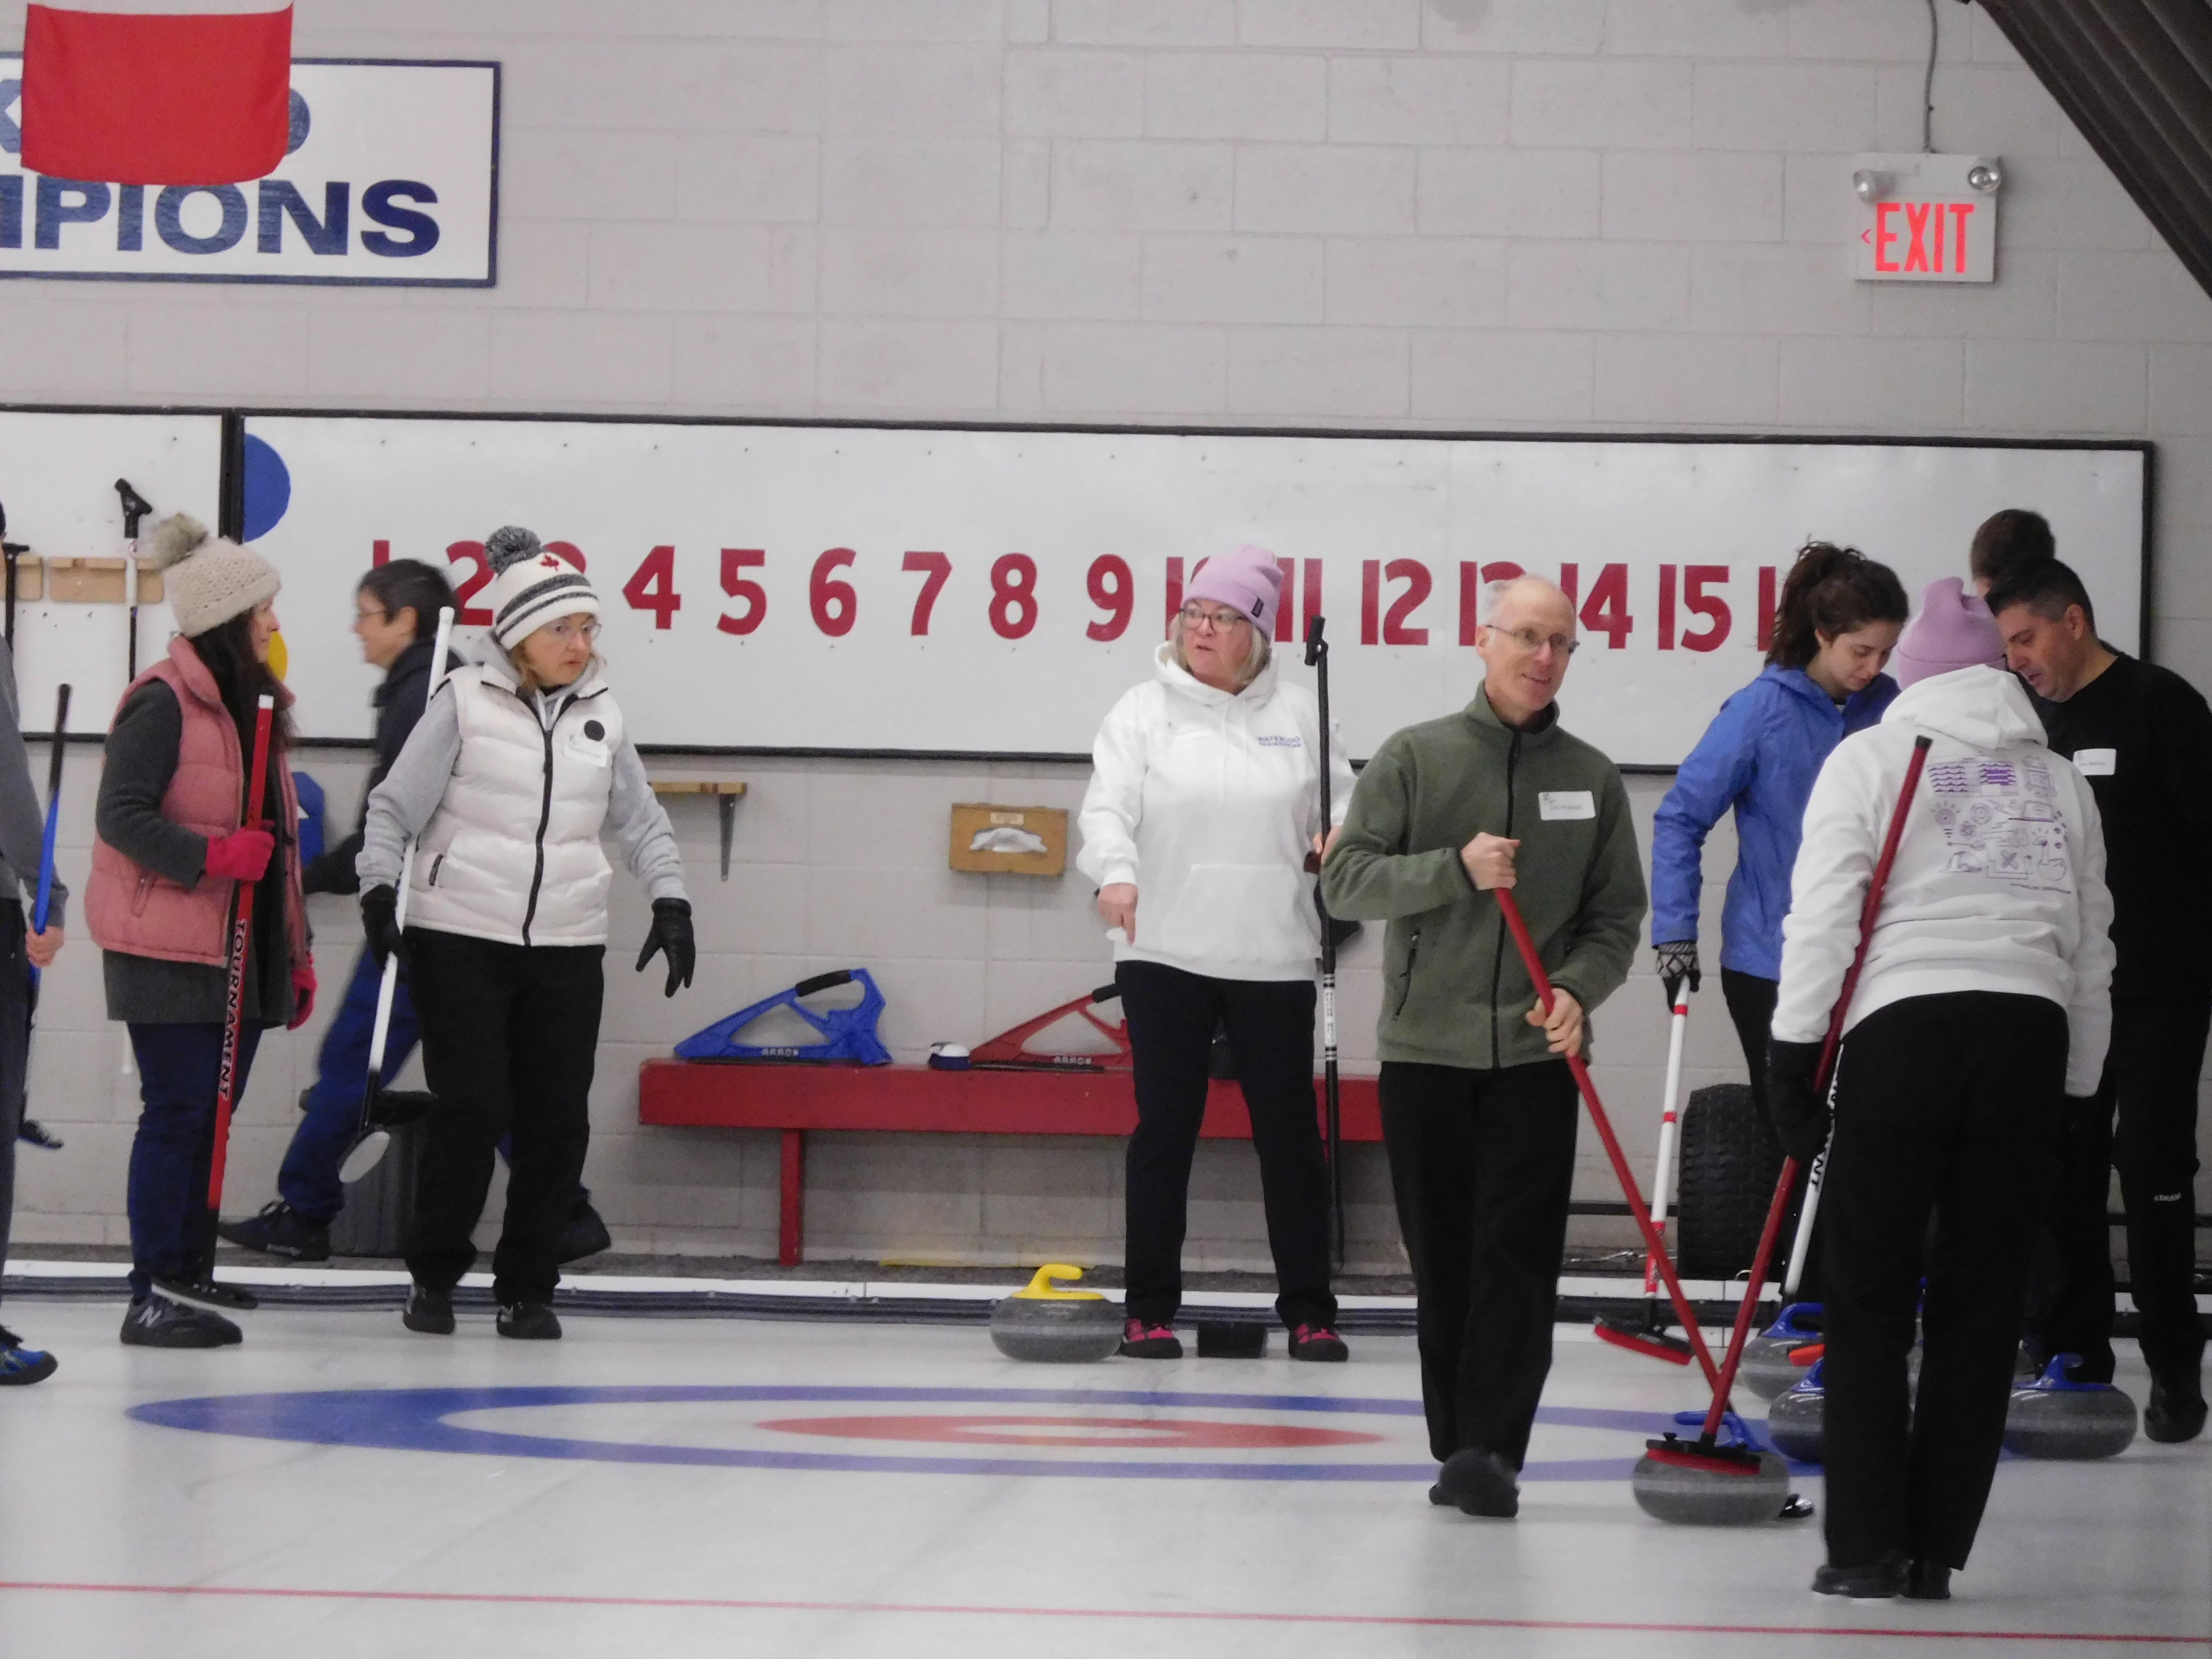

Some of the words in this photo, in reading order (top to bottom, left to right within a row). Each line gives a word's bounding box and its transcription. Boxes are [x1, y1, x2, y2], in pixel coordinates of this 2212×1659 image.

[1875, 202, 1975, 273] EXIT
[446, 541, 495, 626] 2
[623, 546, 682, 629] 4
[717, 548, 767, 635] 5
[810, 548, 857, 637] 6
[902, 552, 953, 636] 7
[989, 553, 1038, 639] 8
[1086, 554, 1134, 642] 9
[1274, 557, 1323, 642] 11
[1360, 558, 1432, 646] 12
[1658, 564, 1732, 652] 15
[218, 919, 247, 1100] TOURNAMENT
